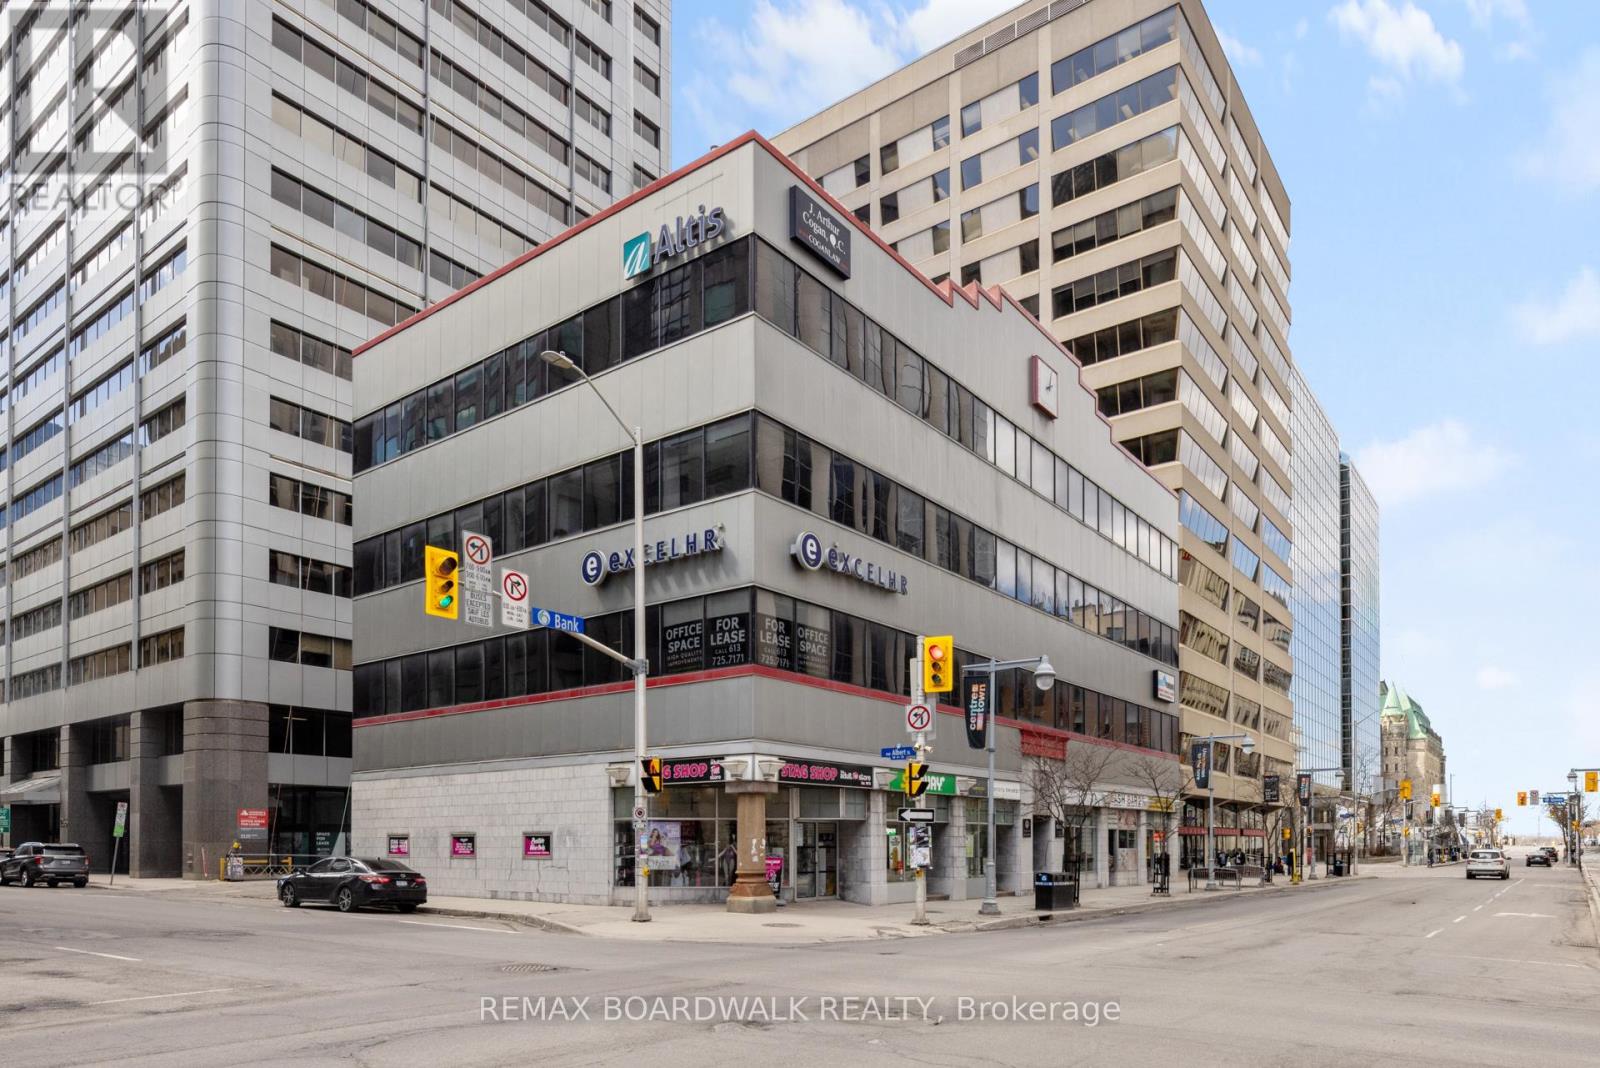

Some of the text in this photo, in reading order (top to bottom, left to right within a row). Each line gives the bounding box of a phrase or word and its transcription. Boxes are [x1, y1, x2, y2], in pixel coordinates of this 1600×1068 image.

[809, 203, 840, 236] J. Arthur
[653, 204, 725, 264] Altis
[554, 612, 580, 633] Bank
[716, 617, 740, 632] FOR
[765, 617, 785, 634] FOR
[665, 622, 703, 641] OFFICE
[710, 630, 746, 646] LEASE
[759, 630, 791, 649] LEASE
[797, 626, 829, 645] OFFICE
[668, 637, 701, 654] SPACE
[728, 643, 741, 653] 613
[799, 640, 827, 657] SPACE
[711, 653, 745, 666] 725.7171
[977, 683, 986, 713] town
[892, 749, 906, 757] Albert
[673, 763, 708, 779] SHOP
[781, 763, 838, 782] STAG SHOP
